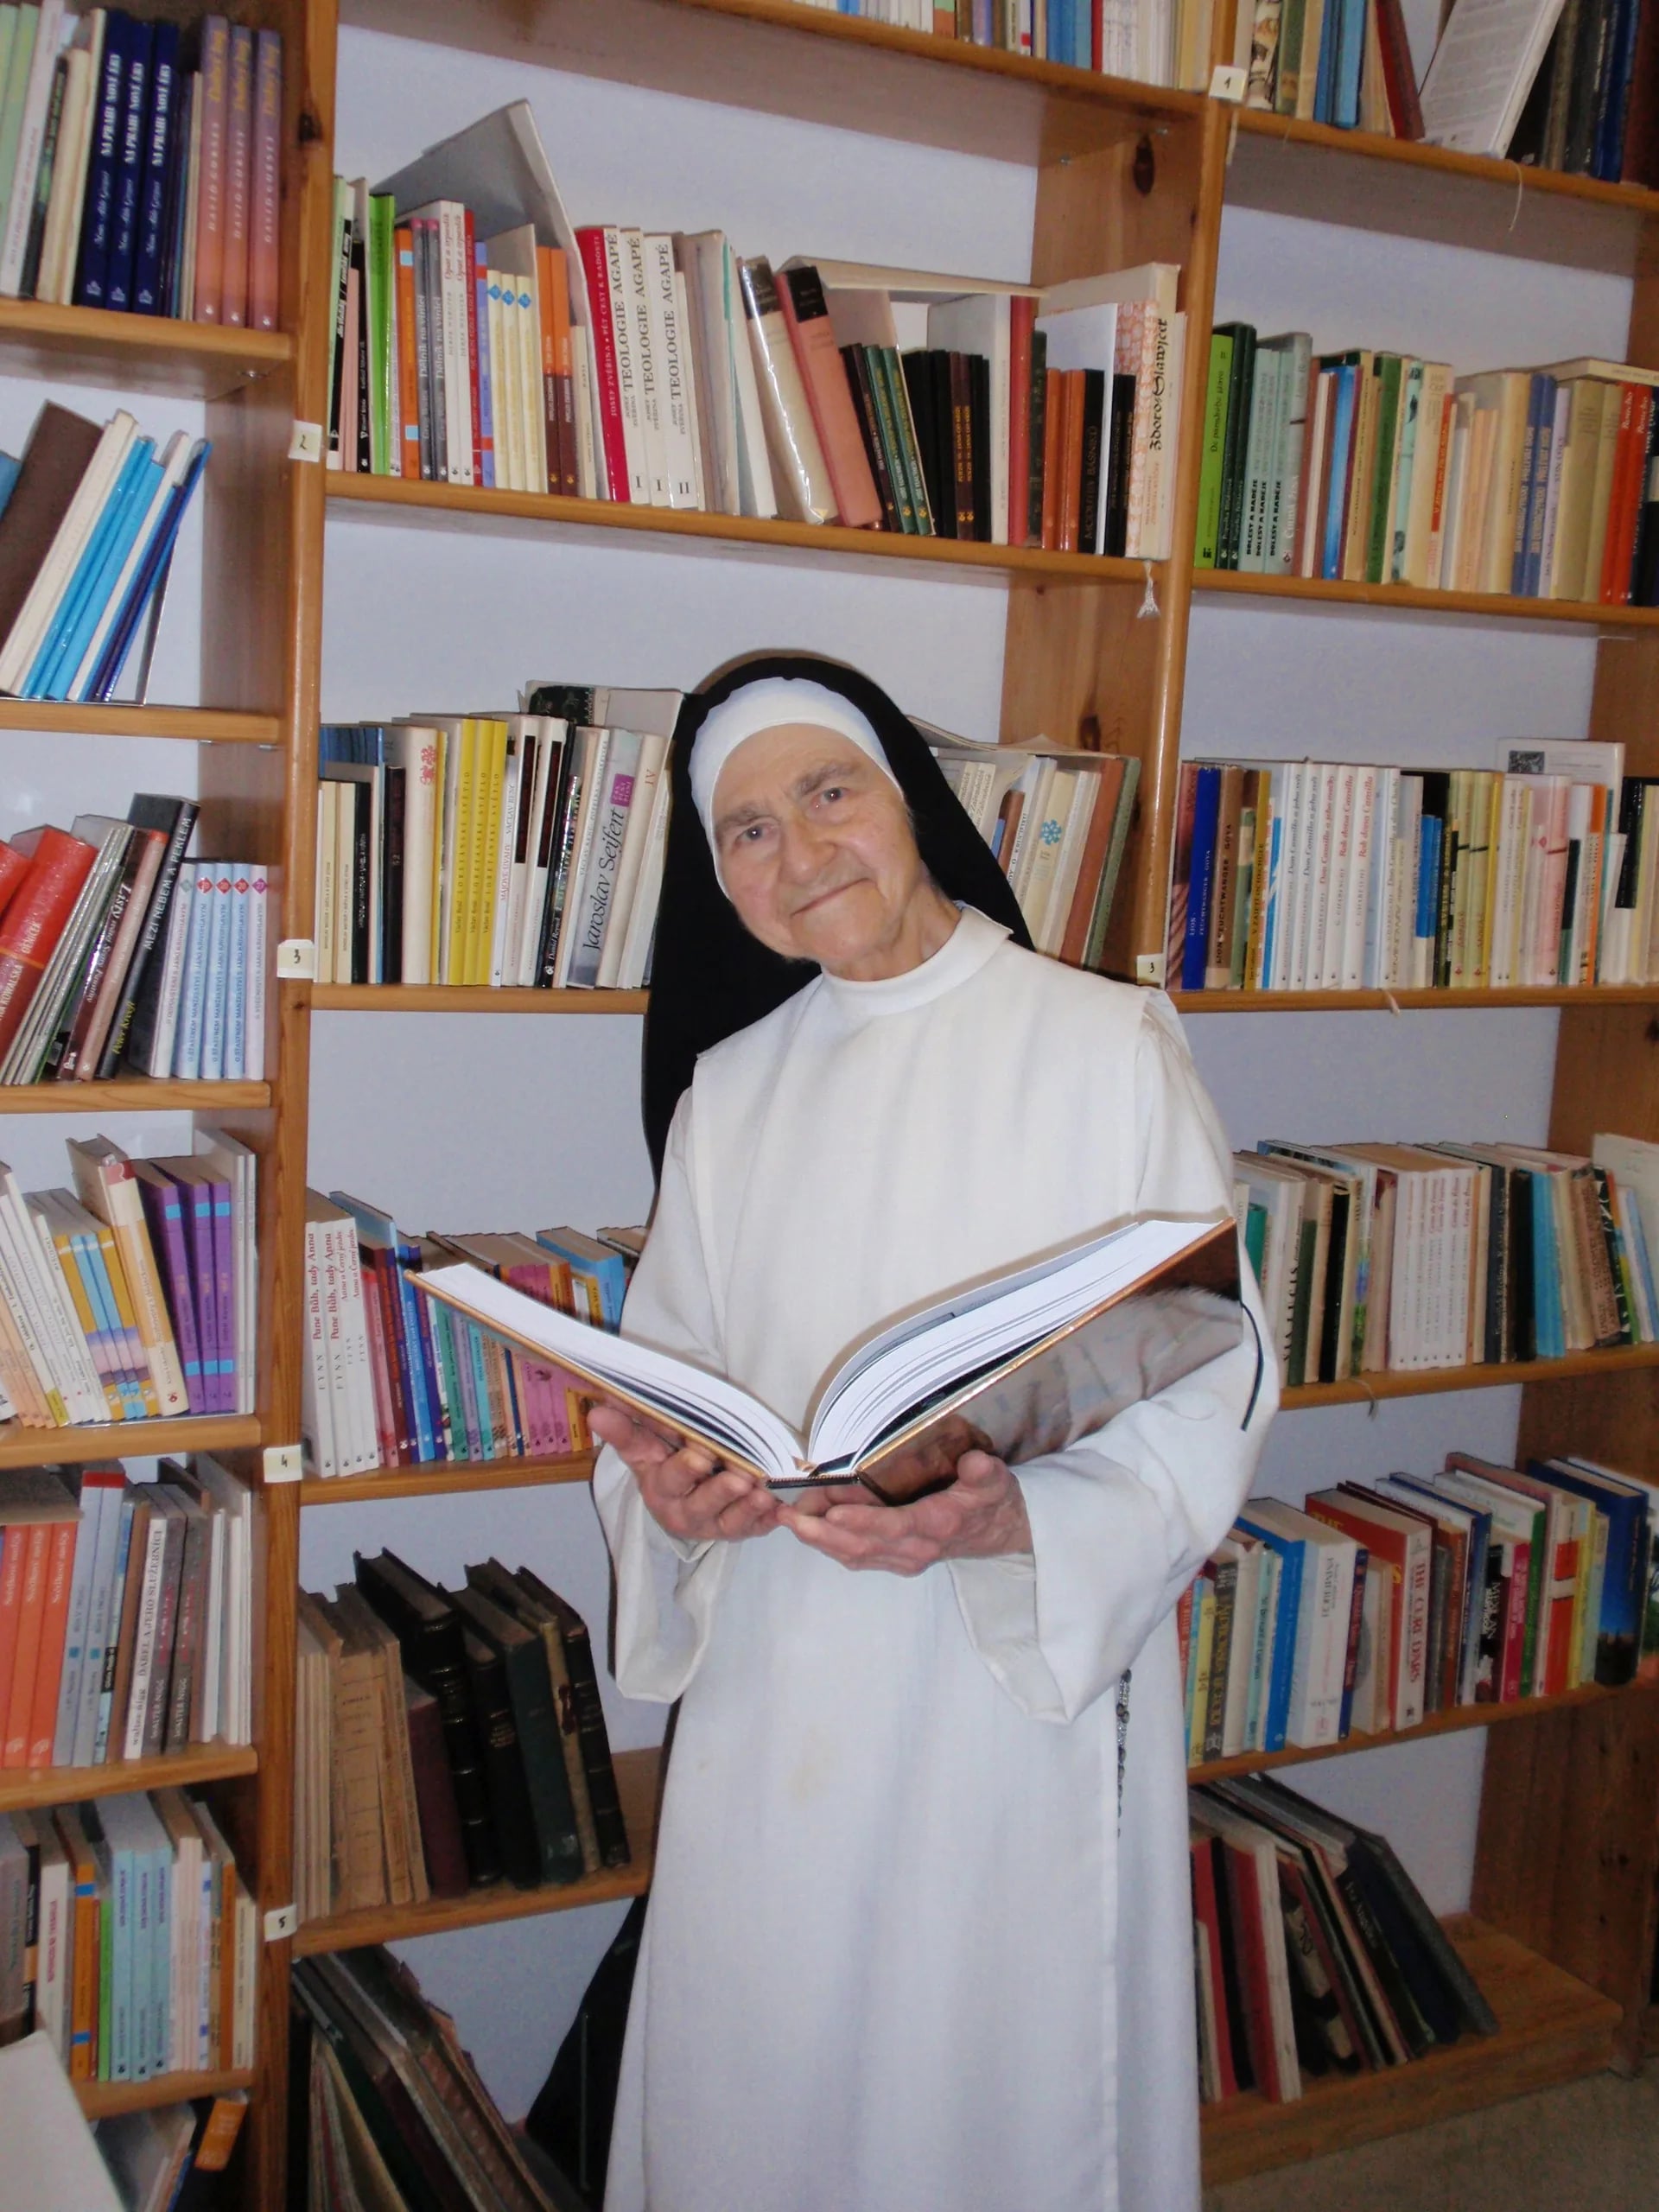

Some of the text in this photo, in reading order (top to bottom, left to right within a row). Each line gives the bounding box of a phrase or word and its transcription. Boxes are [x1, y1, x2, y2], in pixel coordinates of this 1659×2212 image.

[443, 259, 454, 280] Opat
[454, 261, 466, 282] Opat
[594, 236, 604, 278] RADOSTI
[600, 291, 608, 315] CEST
[605, 233, 633, 391] TEOLOGIE AGAPÉ
[628, 237, 656, 395] TEOLOGIE AGAPÉ
[419, 330, 426, 341] na
[435, 331, 443, 344] na
[657, 244, 682, 399] TEOLOGIE AGAPÉ
[418, 346, 428, 377] Dělník
[435, 346, 444, 378] Dělník
[606, 345, 616, 387] ZVĚŘINA
[608, 389, 618, 417] JOSEF
[1249, 479, 1258, 512] NADĚJE
[1258, 481, 1268, 515] NADĚJE
[1273, 480, 1281, 514] NADĚJE
[1246, 521, 1255, 555] BOLEST
[1255, 524, 1265, 556] BOLEST
[1269, 524, 1278, 556] BOLEST
[475, 772, 486, 815] SVĚTLO
[645, 769, 657, 785] IV
[490, 773, 500, 816] SVĚTLO
[1338, 775, 1354, 857] Rok dona Camilla
[1358, 776, 1373, 857] Rok dona Camilla
[454, 916, 463, 933] Václav
[460, 772, 470, 814] SVĚTLO
[499, 806, 514, 900] MÁJOVÉ VÁCLAV
[1224, 823, 1232, 850] GOYA
[1289, 820, 1298, 853] Camillo
[1304, 822, 1315, 855] Camillo
[1321, 829, 1331, 864] Camillo
[1388, 833, 1397, 867] Camillo
[582, 808, 626, 950] Jaroslav Seifert
[1287, 855, 1296, 874] Don
[1302, 857, 1311, 876] Don
[143, 817, 191, 949] MEZI NEBEM A PEKLEM
[111, 883, 132, 918] Listy
[1199, 877, 1209, 936] FEUCHTWANGER
[0, 921, 42, 1006] KOWALSKA DENÍČEK
[294, 949, 301, 963] 3
[111, 1031, 130, 1054] Peter
[335, 1230, 346, 1249] jezdec
[347, 1228, 358, 1248] jezdec
[336, 1249, 348, 1271] Černý
[347, 1248, 359, 1268] Černý
[340, 1280, 348, 1302] Anna
[352, 1277, 360, 1299] Anna
[306, 1233, 326, 1390] FYNN Pane Bůh, tady Anna
[323, 1233, 343, 1390] FYNN Pane Bůh, tady Anna
[146, 1529, 162, 1596] SLUŽEBNÍCI
[50, 1560, 65, 1604] Svědkové
[144, 1599, 156, 1628] JEHO
[135, 1688, 147, 1710] nigg
[149, 1678, 165, 1738] WALTER NIGG
[174, 1677, 188, 1738] WALTER NIGG
[131, 1713, 143, 1745] walter
